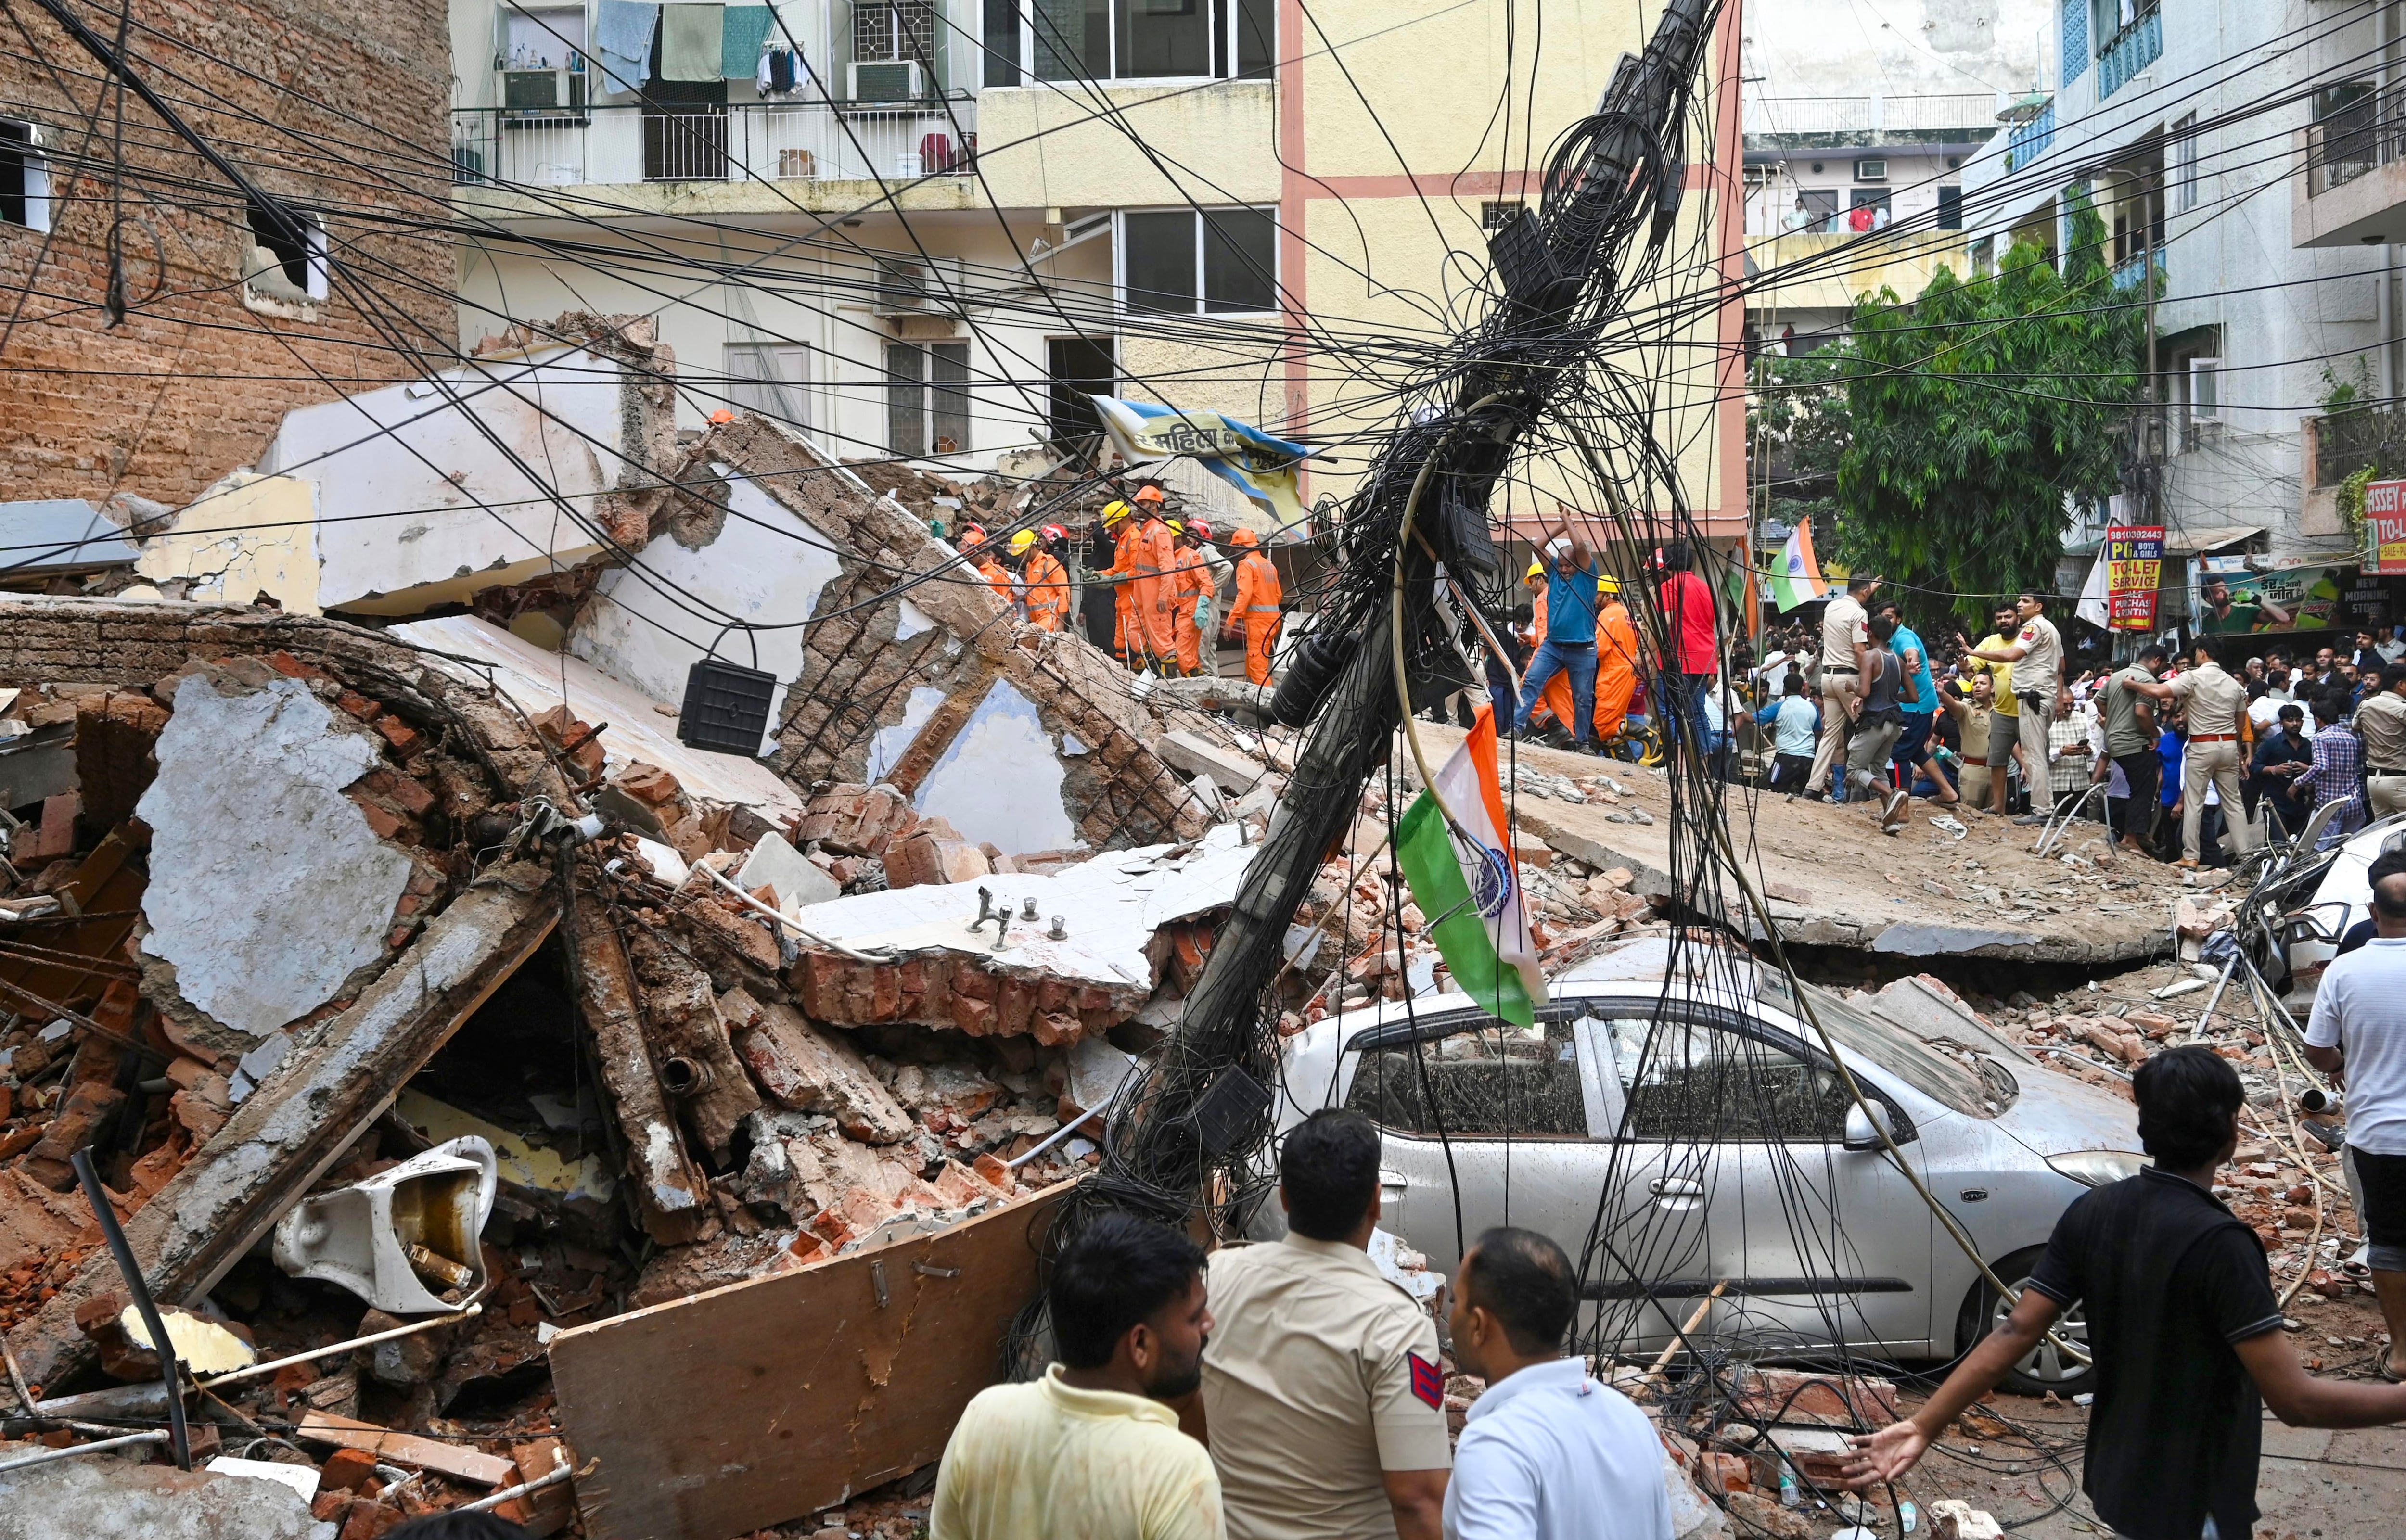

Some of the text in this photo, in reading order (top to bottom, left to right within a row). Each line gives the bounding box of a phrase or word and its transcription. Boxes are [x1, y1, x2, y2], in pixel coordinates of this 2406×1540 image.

[1150, 423, 1217, 451] महिला
[2112, 541, 2133, 560] PG
[2111, 561, 2159, 575] TO-LET
[2113, 577, 2156, 588] SERVICE
[2261, 578, 2278, 590] डर
[2285, 579, 2302, 588] आगे
[2356, 577, 2379, 589] NEW
[2268, 586, 2295, 599] जीत
[2345, 589, 2390, 602] MORNING
